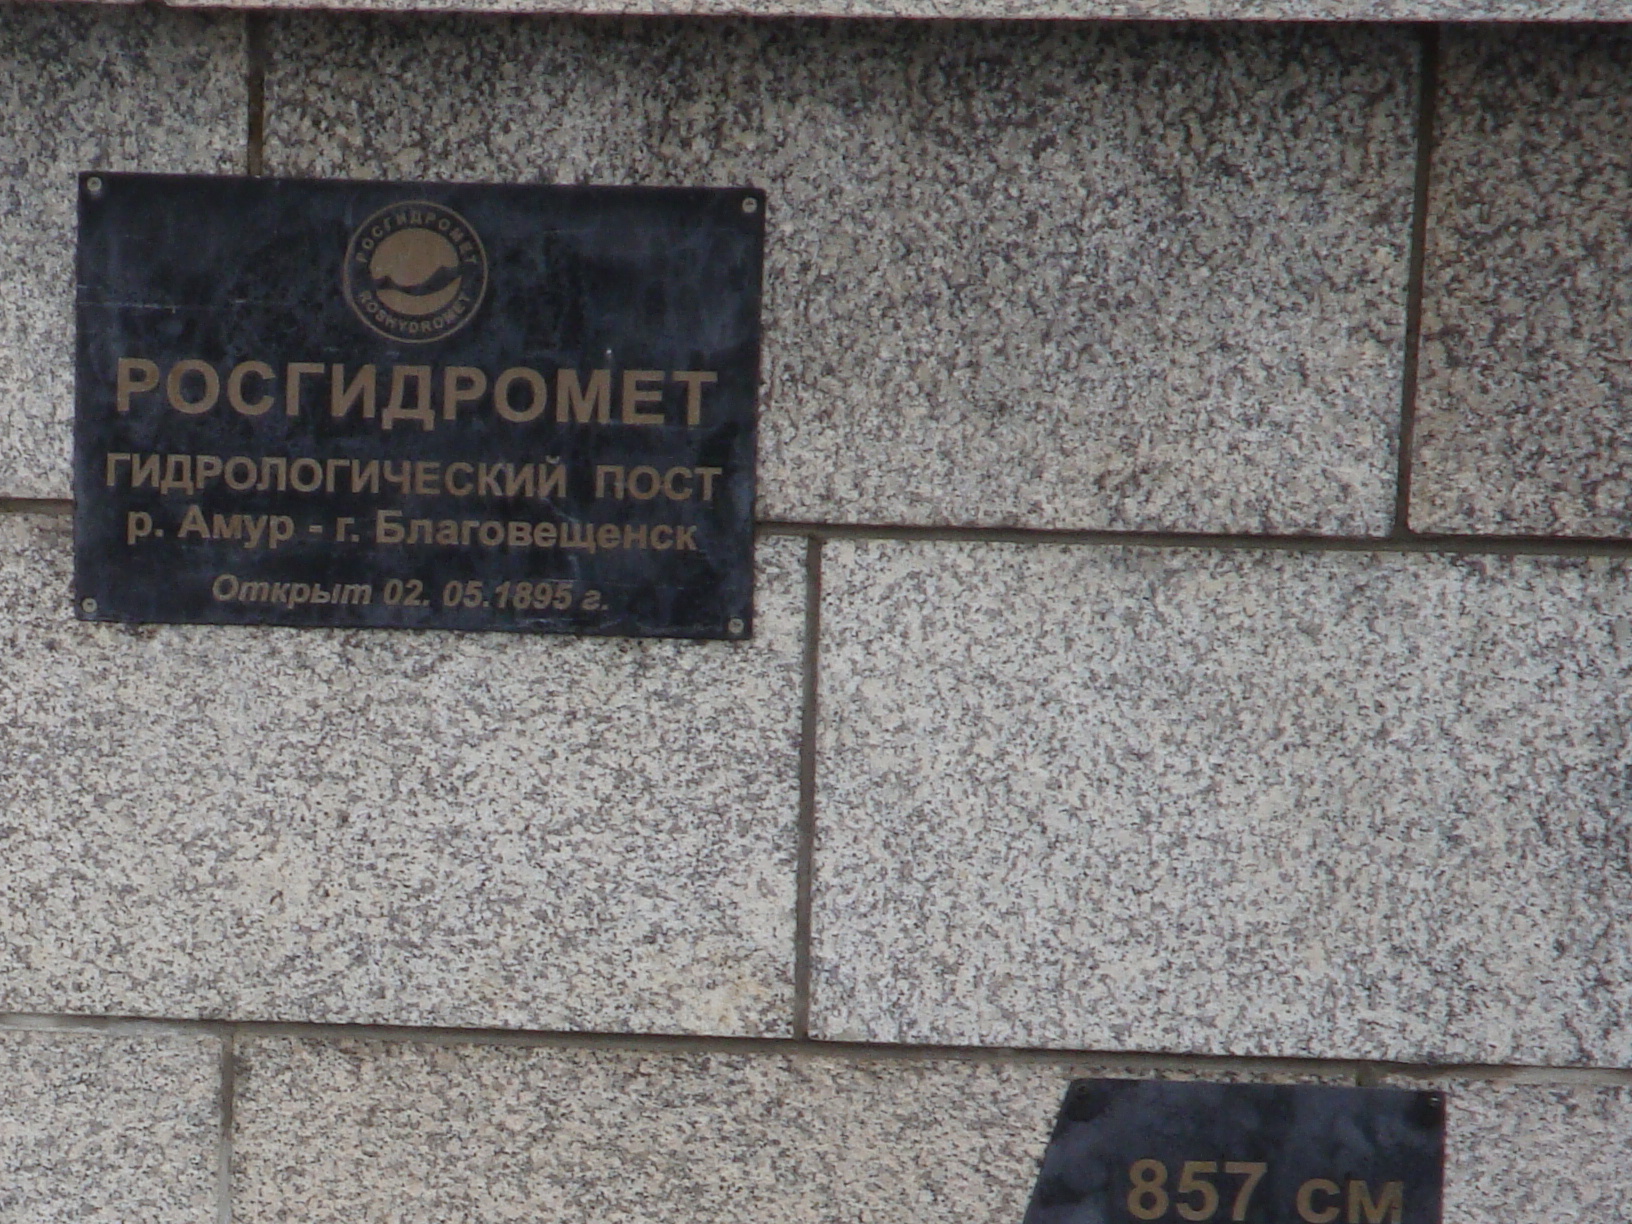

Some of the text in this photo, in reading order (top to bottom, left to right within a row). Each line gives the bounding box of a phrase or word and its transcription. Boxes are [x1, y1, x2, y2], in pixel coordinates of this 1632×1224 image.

[117, 357, 719, 431] РОСГИДРОМЕТ
[105, 452, 723, 501] ГИДРОЛОГИЧЕСКИЙ ПОСТ
[126, 511, 165, 546] р.
[176, 504, 295, 549] Амур
[335, 516, 361, 543] г.
[375, 509, 698, 555] Благовещенск
[212, 573, 372, 609] Открыт
[1126, 1158, 1269, 1223] 857
